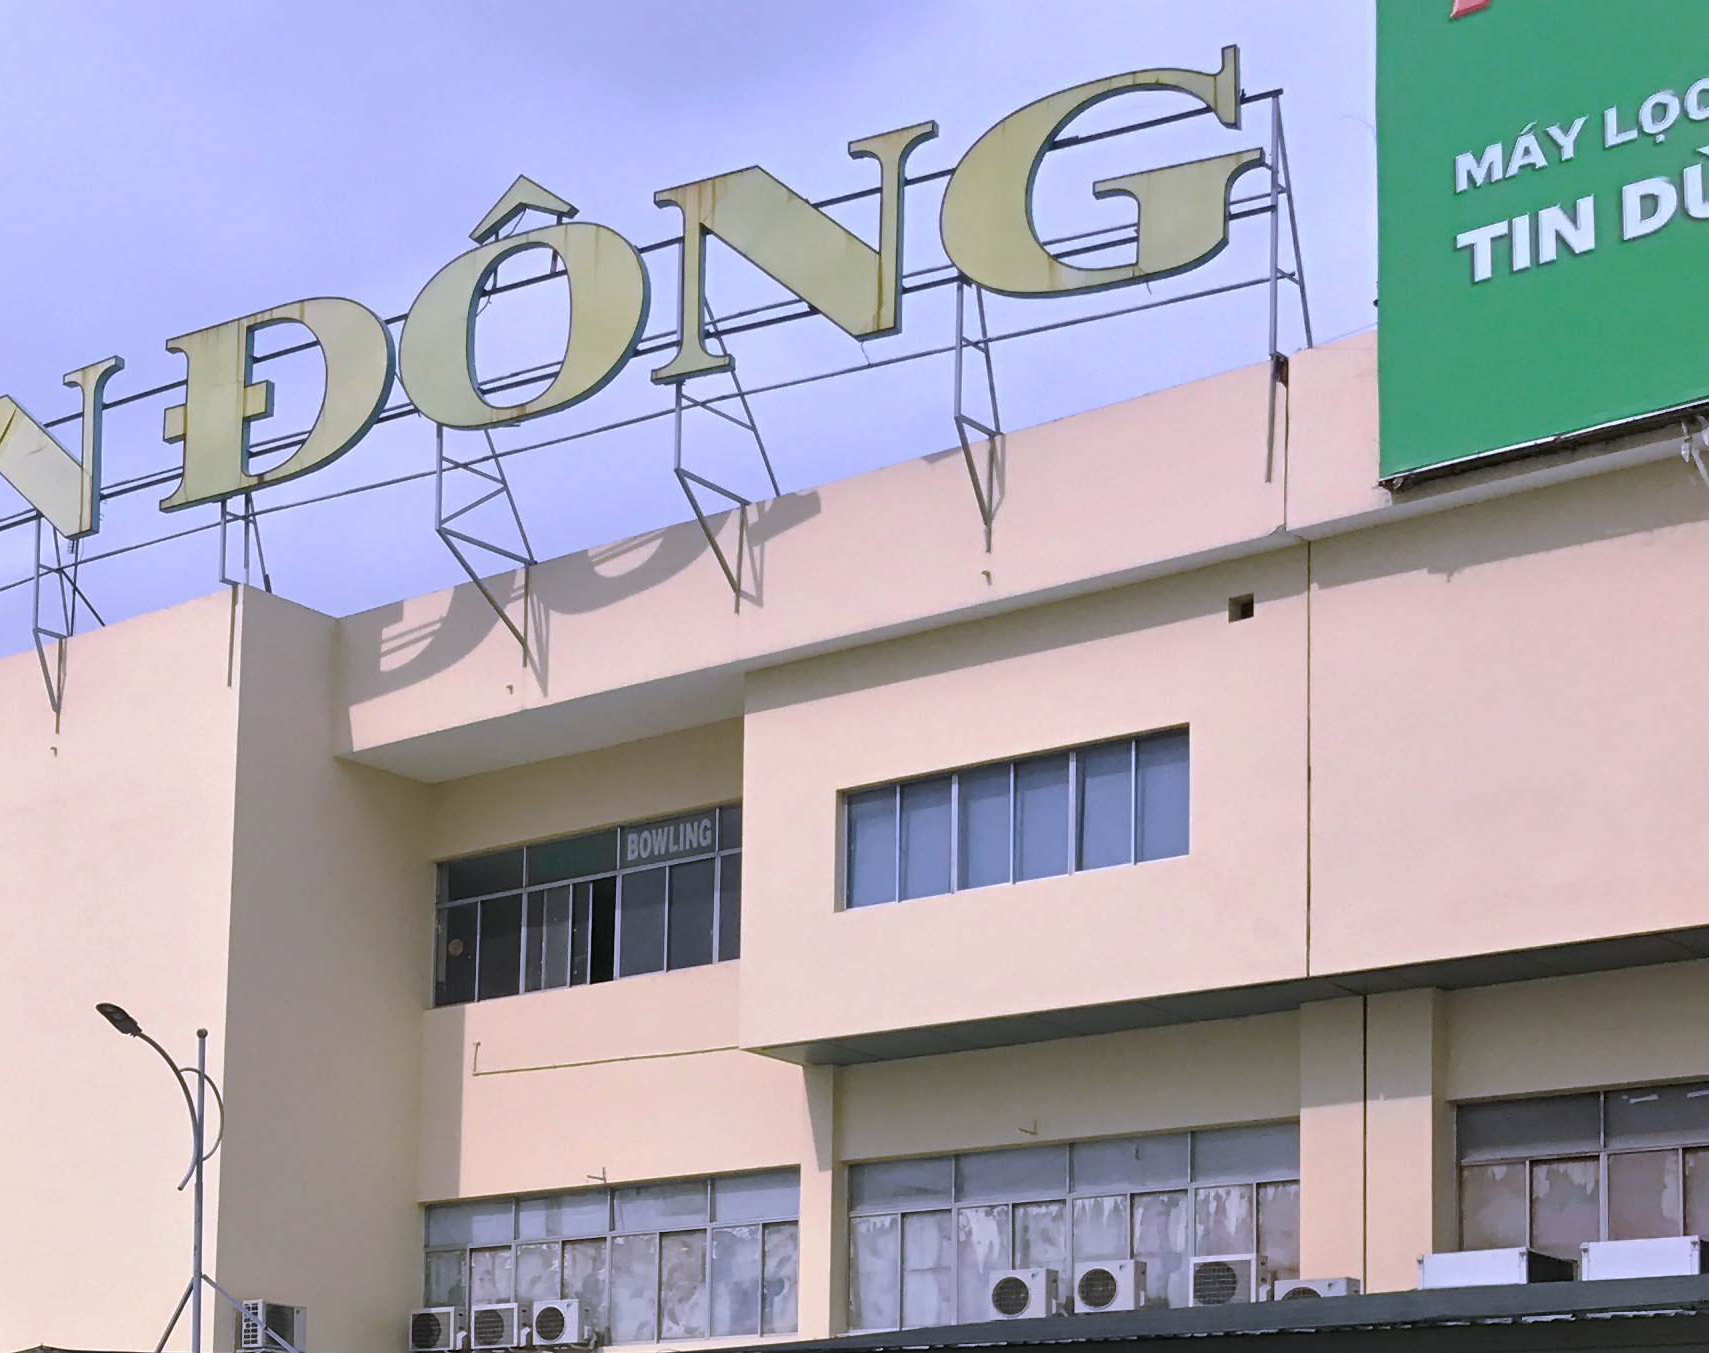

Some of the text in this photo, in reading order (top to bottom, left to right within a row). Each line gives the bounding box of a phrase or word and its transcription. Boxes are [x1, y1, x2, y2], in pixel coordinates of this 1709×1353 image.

[1454, 115, 1589, 194] MÁY
[158, 43, 1265, 513] ĐÔNG
[1456, 194, 1596, 283] TIN
[626, 818, 712, 861] BOWLING
